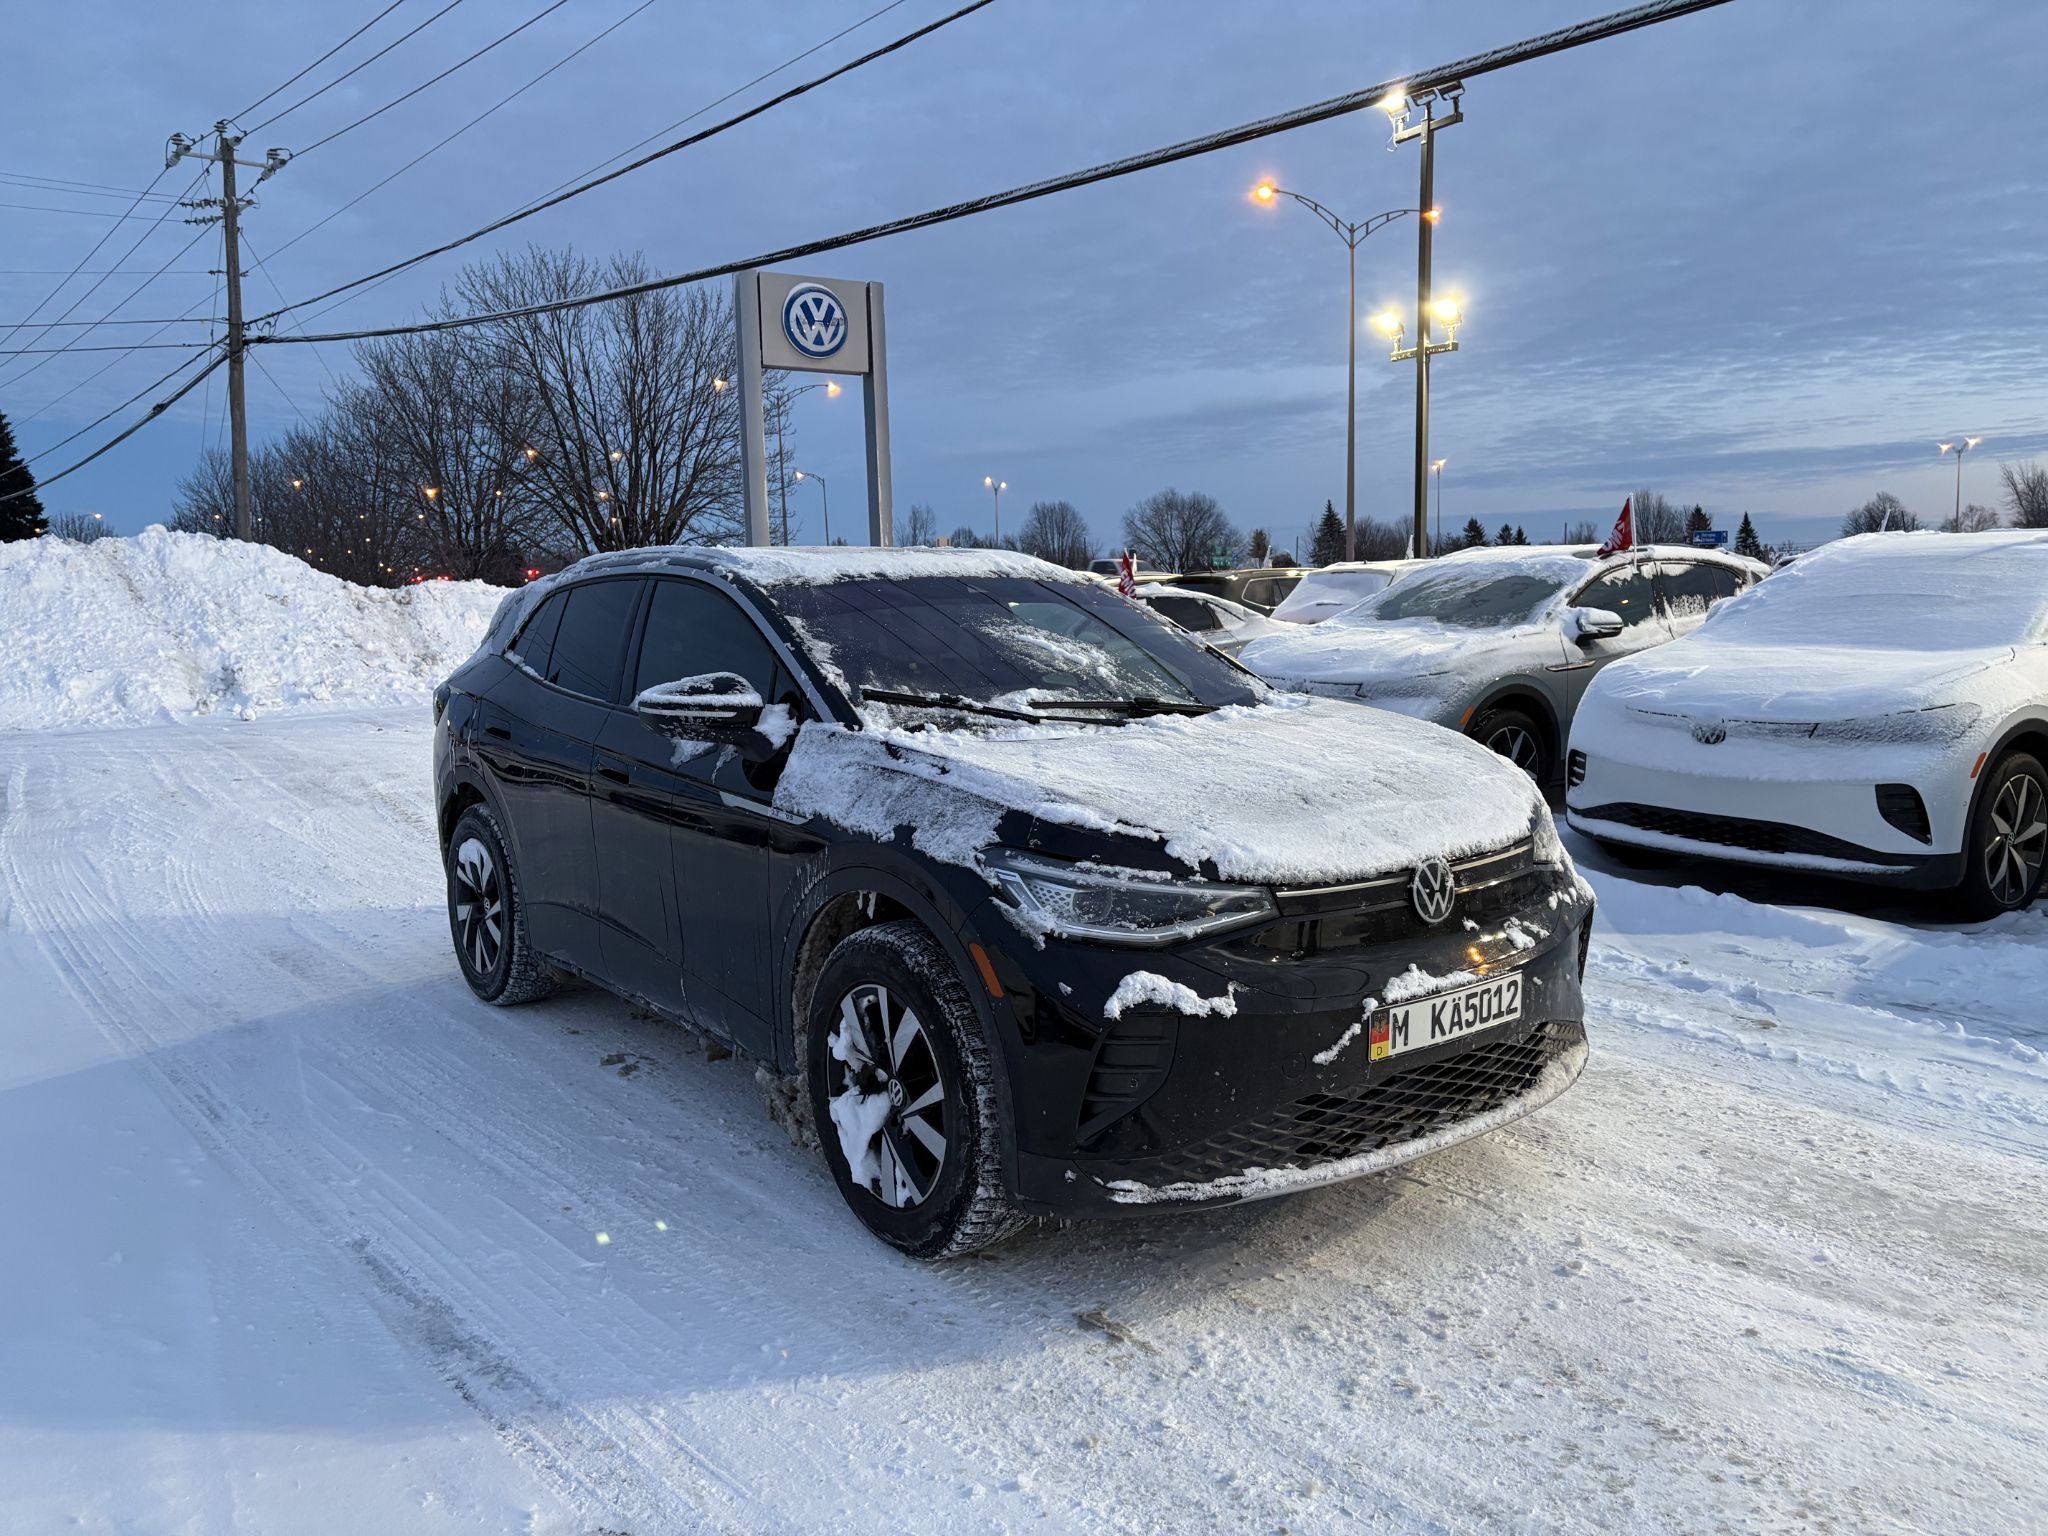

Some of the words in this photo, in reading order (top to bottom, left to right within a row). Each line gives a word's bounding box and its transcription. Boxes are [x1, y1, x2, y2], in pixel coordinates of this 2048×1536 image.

[791, 291, 845, 351] VW
[1414, 861, 1454, 918] VW
[1392, 1009, 1409, 1050] M
[1431, 979, 1519, 1039] KÄ5012
[1376, 1046, 1383, 1057] D
